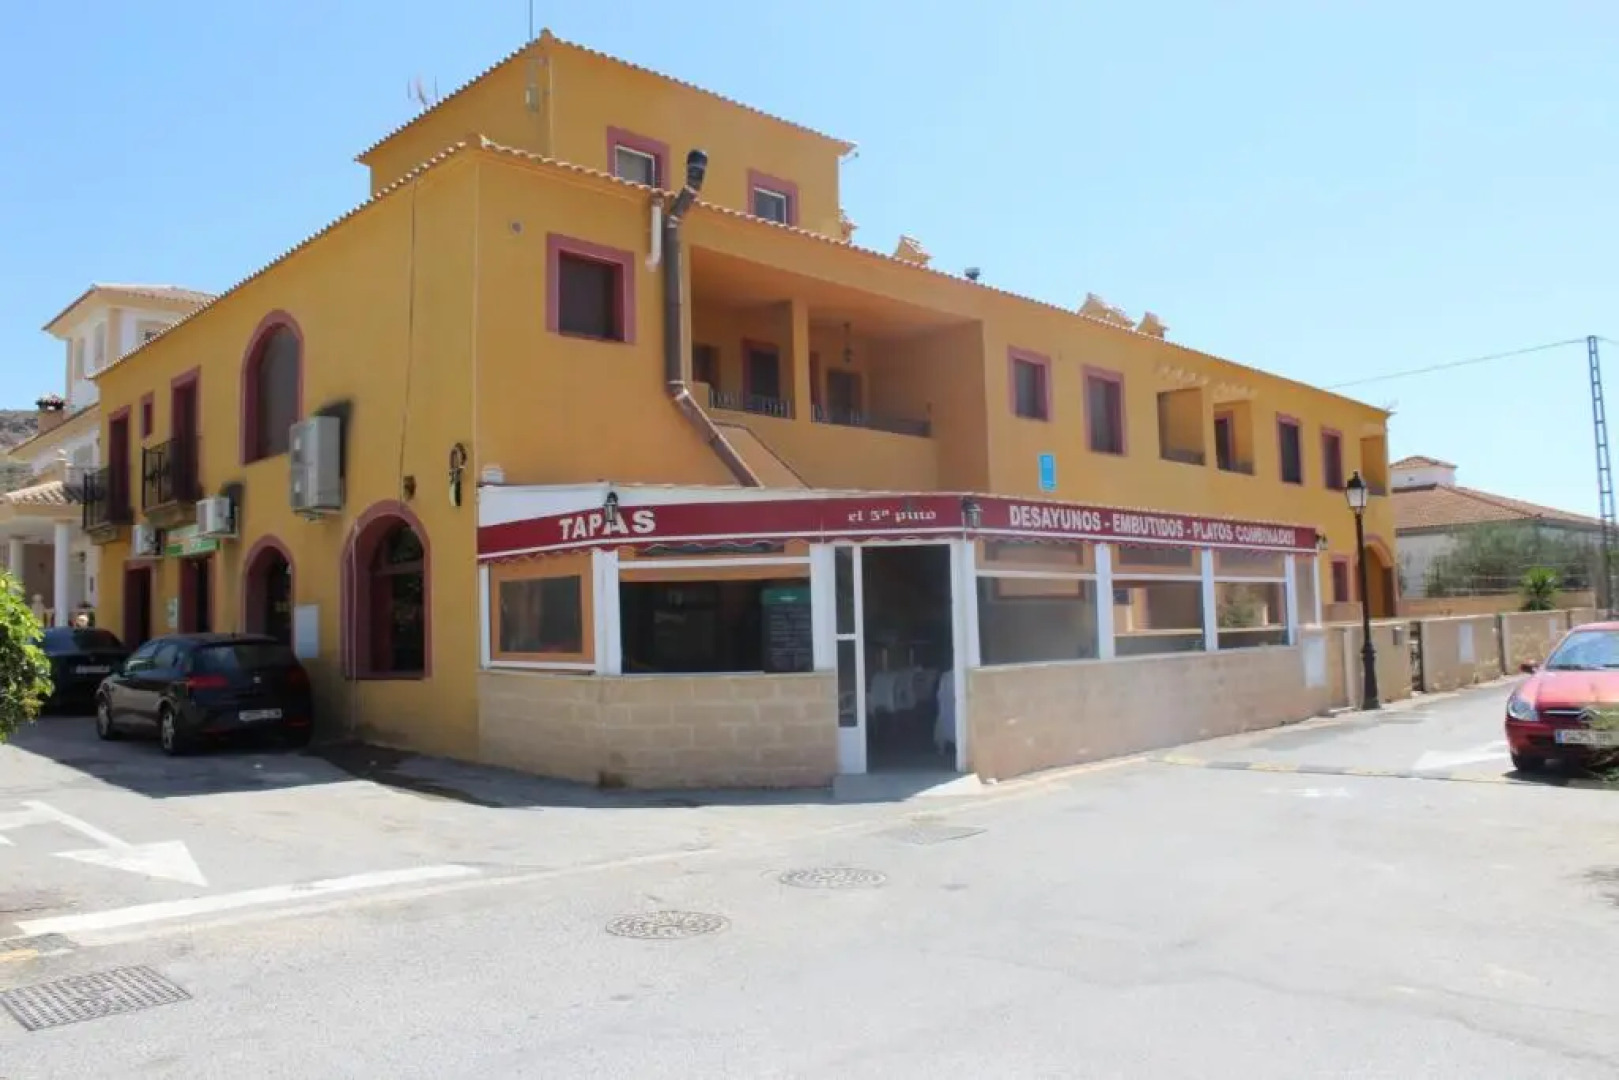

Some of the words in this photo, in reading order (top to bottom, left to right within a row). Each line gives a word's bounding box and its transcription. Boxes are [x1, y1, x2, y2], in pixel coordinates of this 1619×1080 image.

[559, 510, 657, 541] TAPAS
[1009, 505, 1100, 532] DESAYUNOS
[1112, 513, 1184, 537] EMBUTIDOS
[1192, 520, 1234, 541] PLATOS
